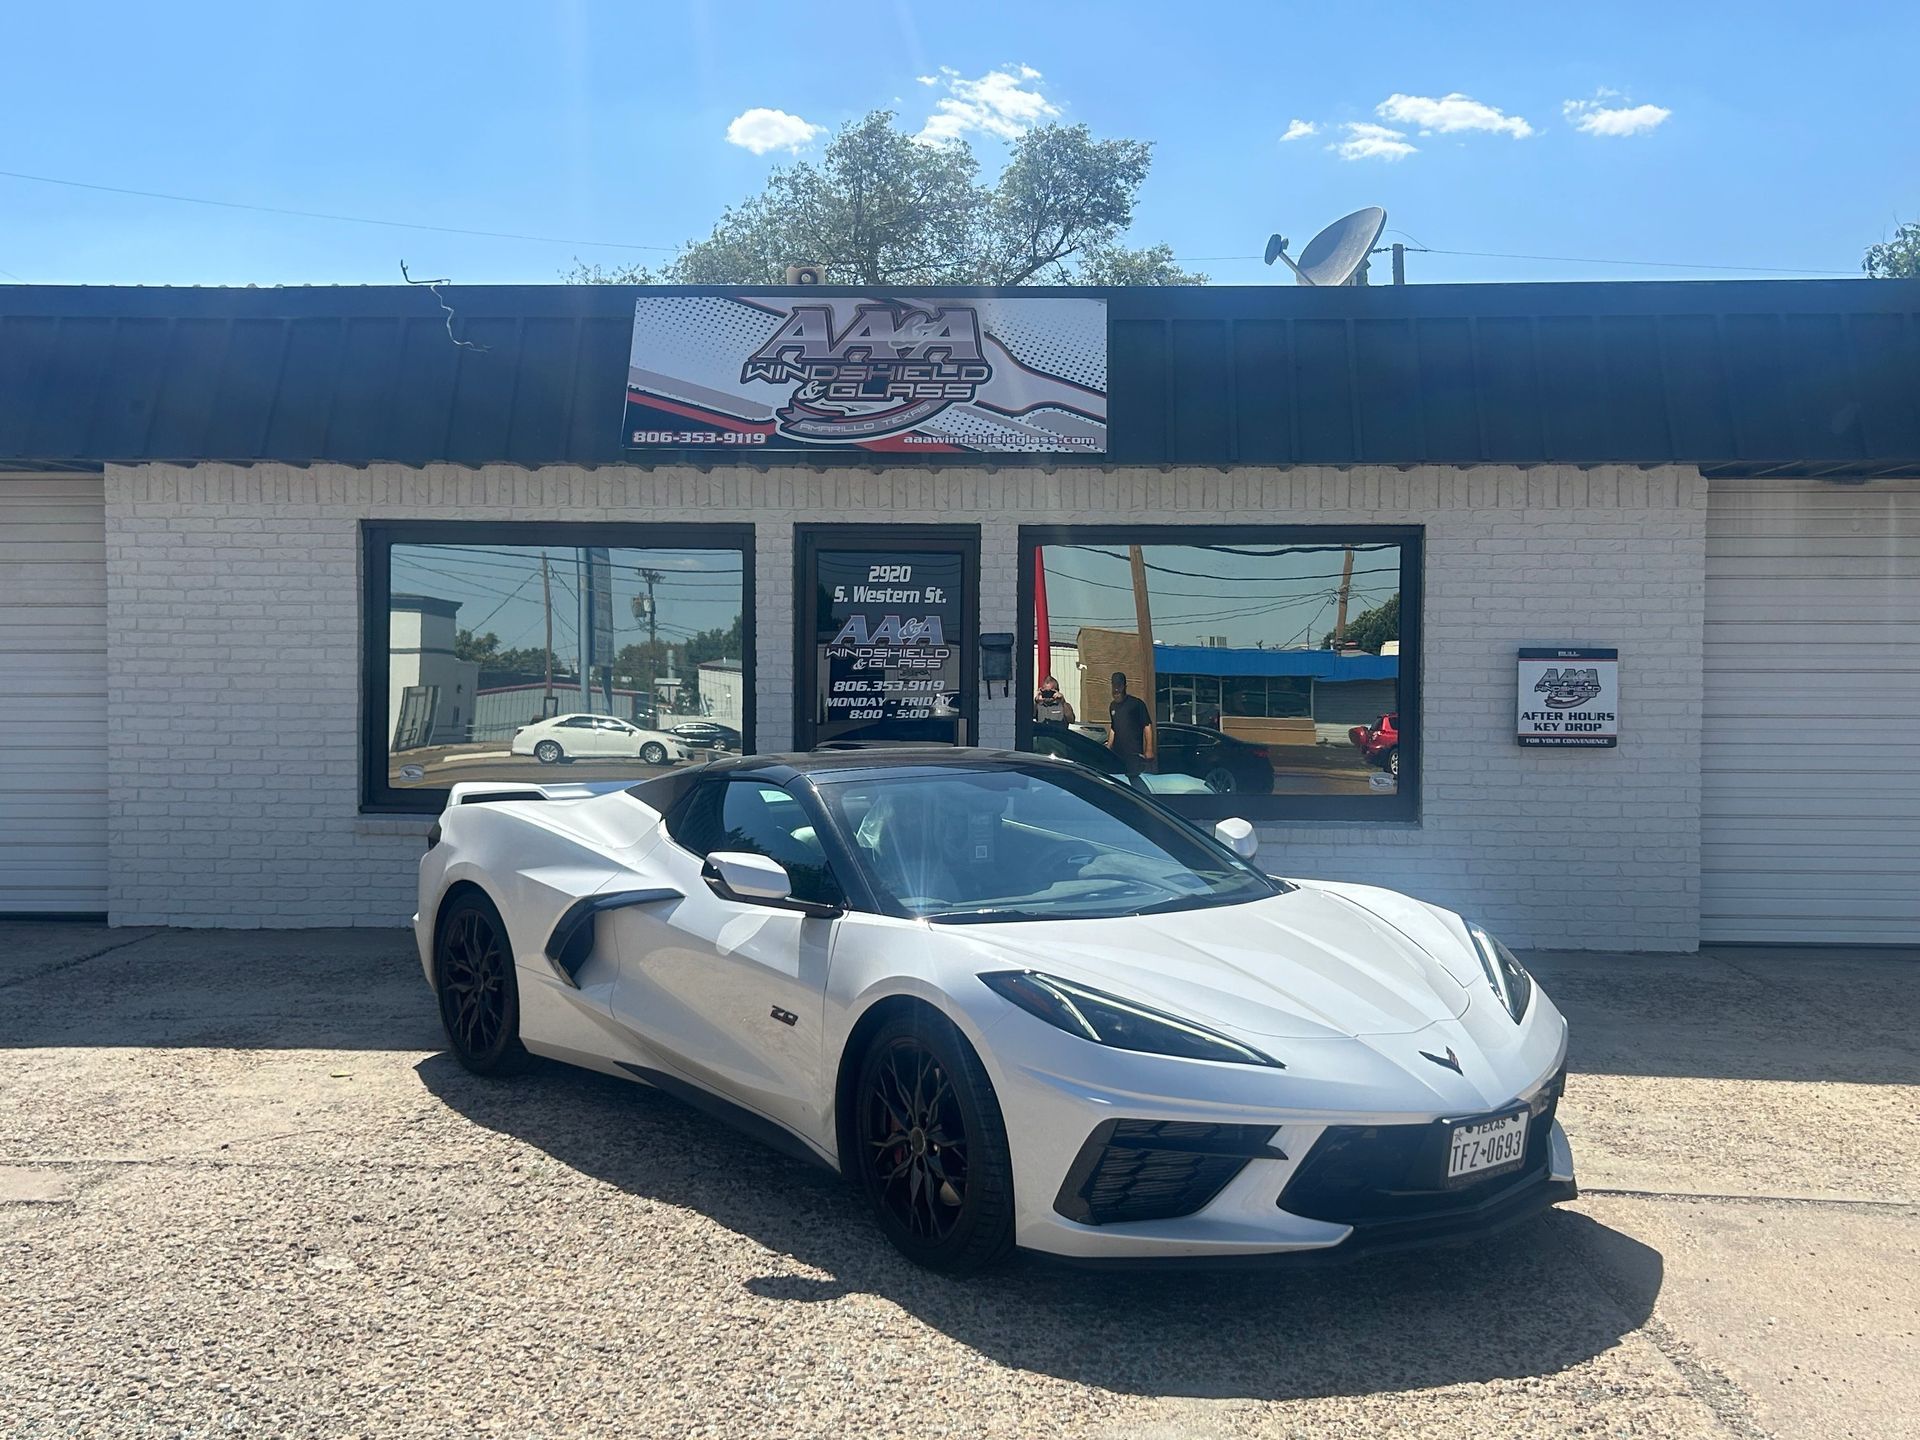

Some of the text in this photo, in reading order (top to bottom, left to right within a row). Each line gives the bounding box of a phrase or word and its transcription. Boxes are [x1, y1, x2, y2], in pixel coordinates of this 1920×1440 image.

[747, 363, 989, 381] WINDSHIELD
[797, 380, 973, 400] & GLASS
[800, 404, 931, 433] AMARILLO TEXAS
[633, 431, 766, 445] 806-353-9119
[903, 432, 1096, 447] aaawindshieldglass.com
[868, 566, 912, 583] 2920
[833, 586, 947, 603] S. Western St.
[826, 648, 950, 658] WINDSHIELD
[853, 658, 941, 670] & GLASS
[833, 680, 945, 691] 806.353.9119
[826, 697, 886, 707] MONDAY
[900, 696, 954, 707] FRIDAY
[849, 709, 883, 719] 8:00
[896, 709, 929, 719] 5:00
[1521, 711, 1615, 721] AFTER HOURS
[1534, 722, 1602, 732] KEY DROP
